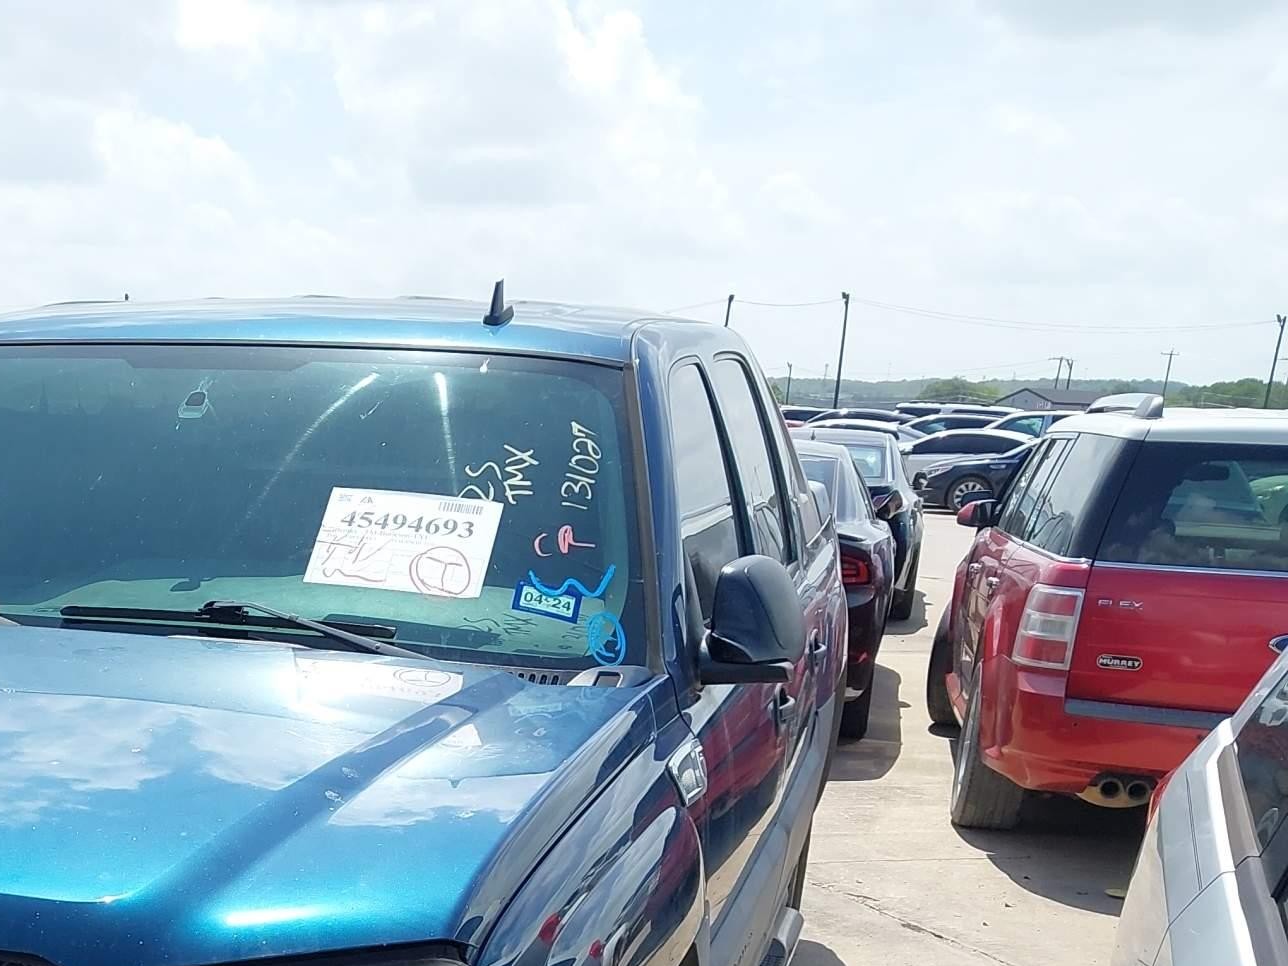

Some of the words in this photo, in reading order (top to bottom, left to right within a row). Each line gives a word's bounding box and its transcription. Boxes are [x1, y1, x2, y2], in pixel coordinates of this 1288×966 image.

[340, 511, 476, 539] 45494693
[524, 592, 544, 605] 04
[551, 597, 572, 611] 24
